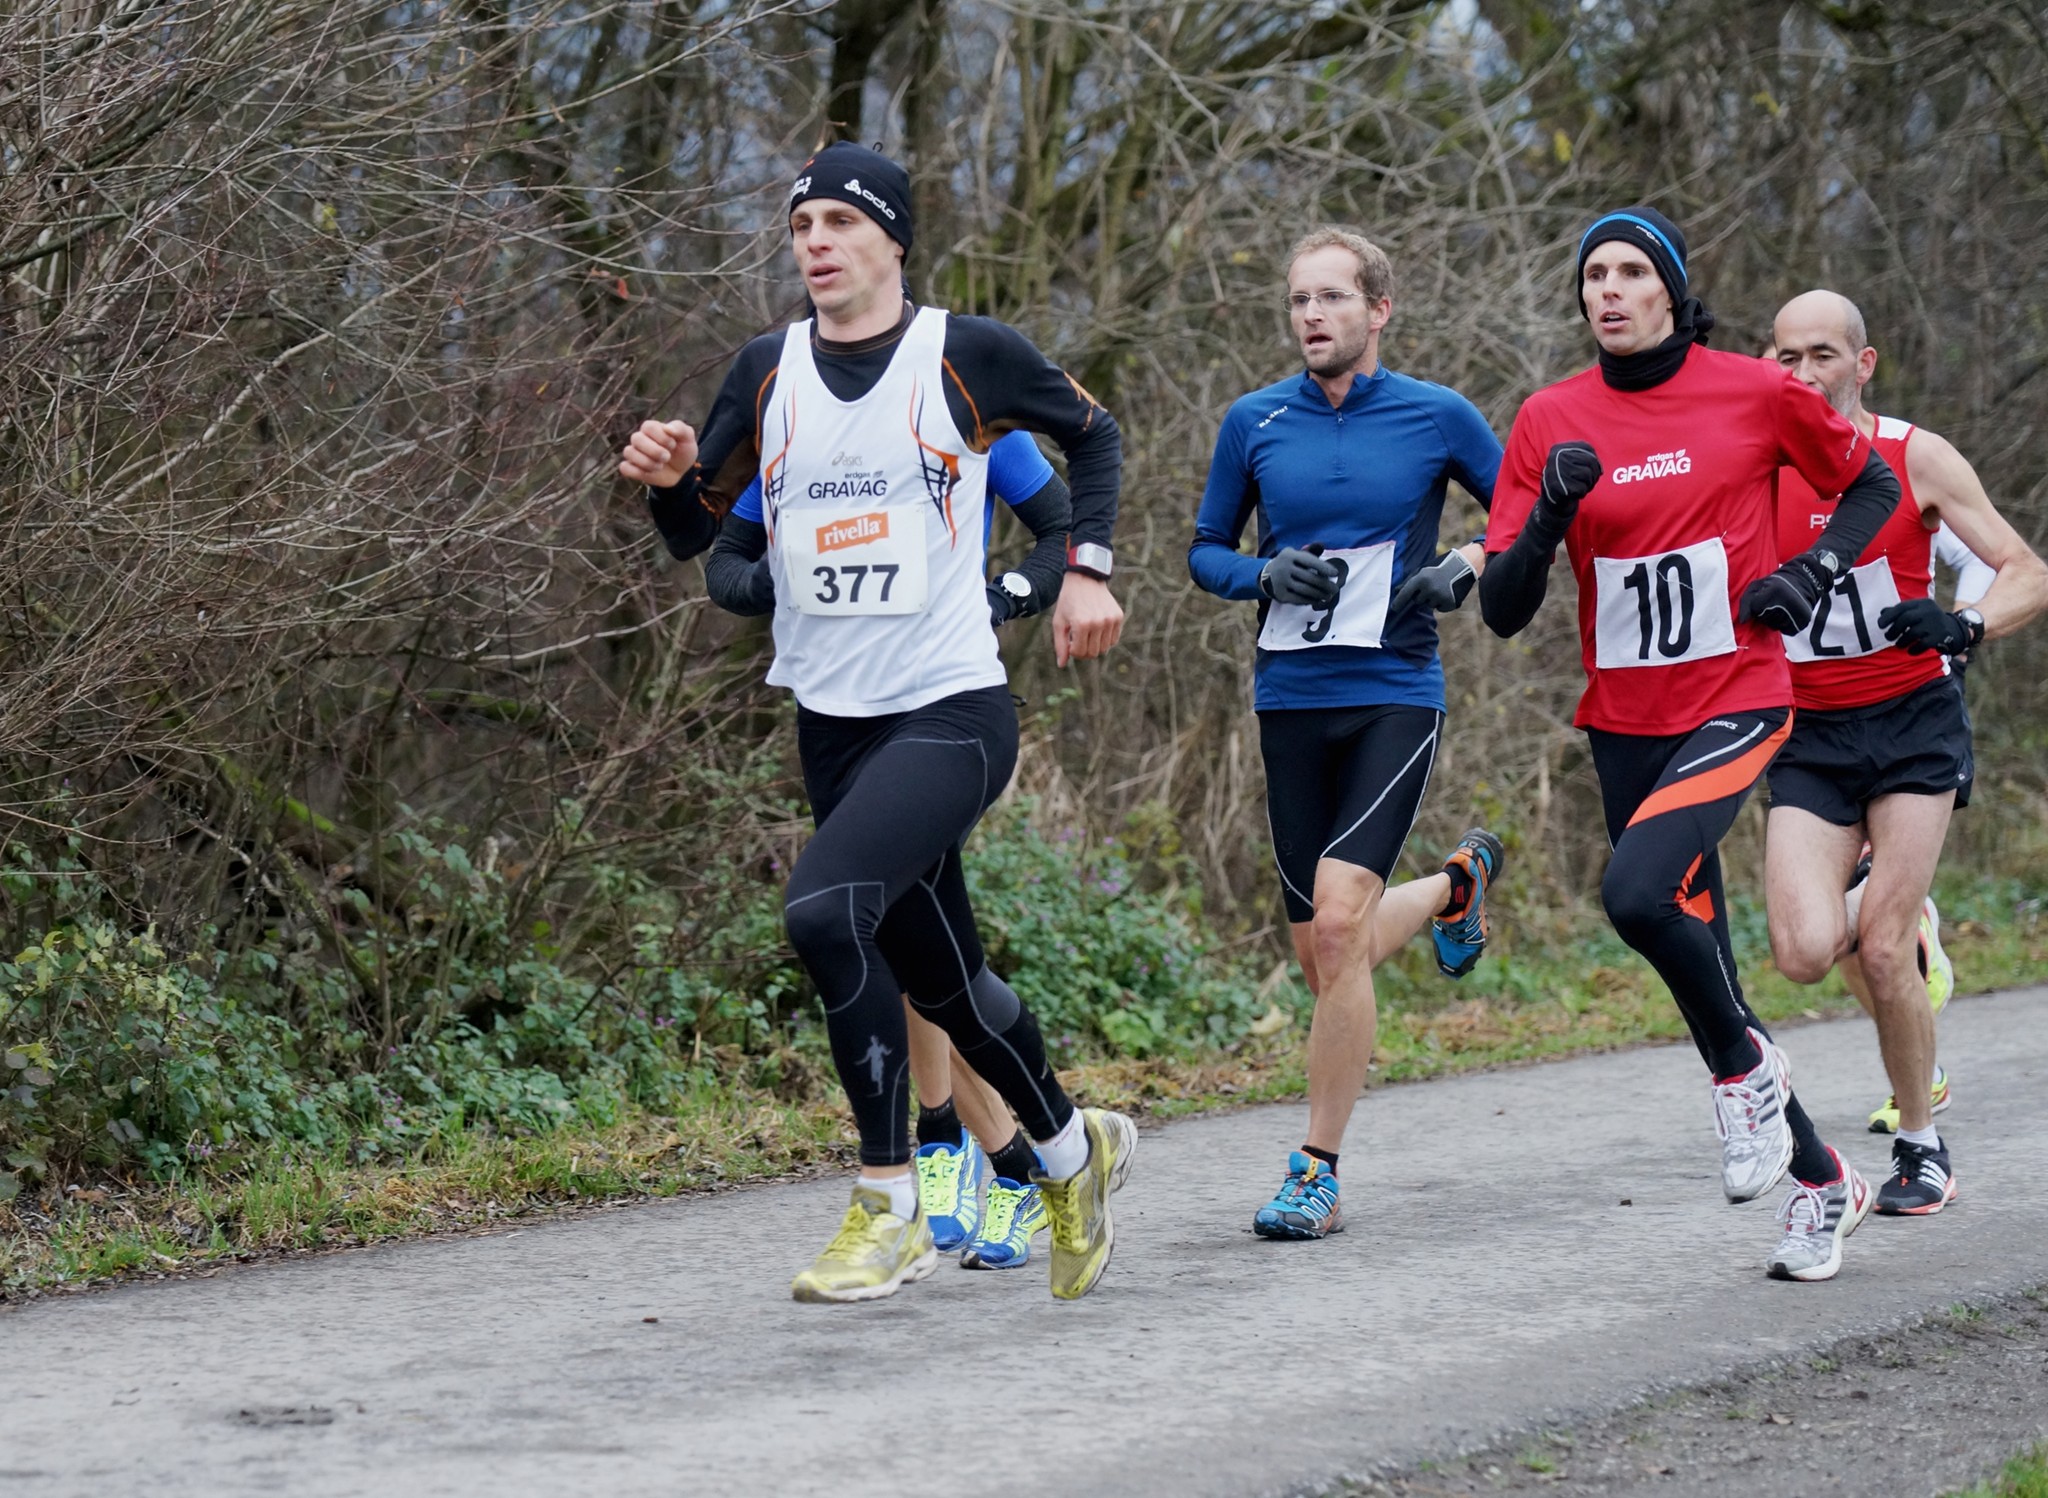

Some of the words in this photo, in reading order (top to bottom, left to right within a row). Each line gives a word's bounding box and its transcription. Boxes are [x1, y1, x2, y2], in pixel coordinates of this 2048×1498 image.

[862, 189, 896, 220] odlo
[1612, 457, 1692, 485] GRAVAG
[1646, 452, 1674, 462] erdgas
[808, 479, 888, 499] GRAVAG
[823, 517, 880, 546] rivella
[812, 563, 900, 604] 377
[1623, 553, 1694, 660] 10
[1809, 572, 1873, 656] 21
